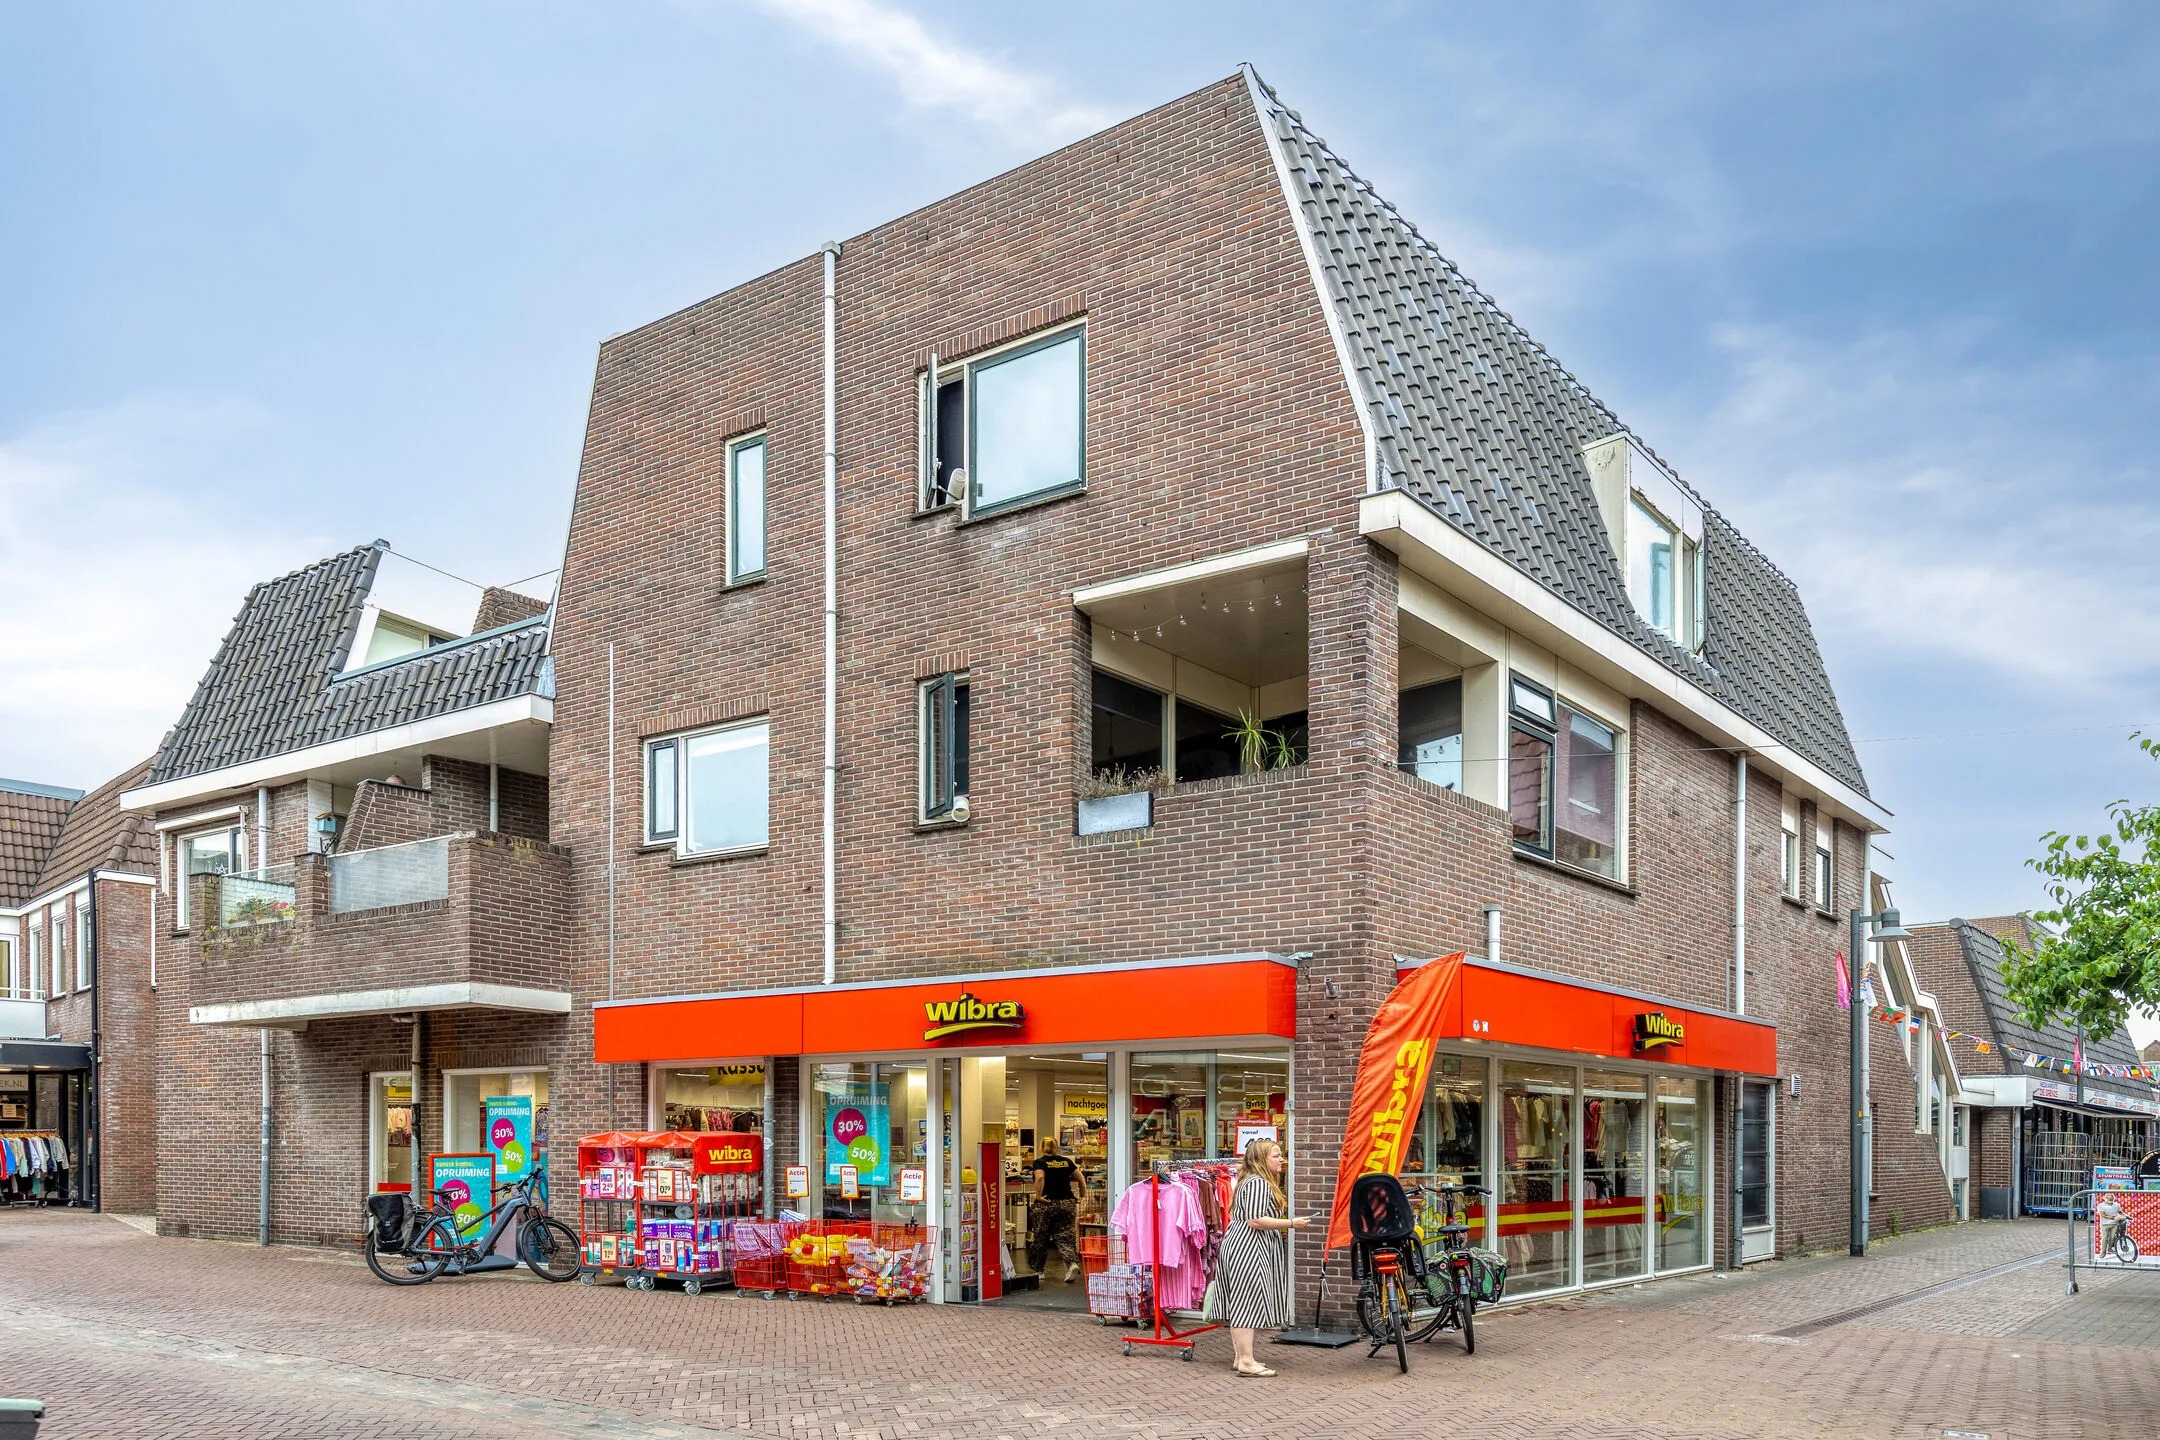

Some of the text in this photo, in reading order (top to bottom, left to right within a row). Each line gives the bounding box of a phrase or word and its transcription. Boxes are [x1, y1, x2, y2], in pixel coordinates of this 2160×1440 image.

[829, 1096, 887, 1106] OPRUIMING
[489, 1108, 530, 1116] OPRUIMING
[838, 1120, 864, 1133] 30%
[495, 1128, 513, 1139] 30%
[505, 1150, 522, 1164] 50%
[852, 1147, 876, 1163] 50%
[435, 1168, 490, 1178] OPRUIMING
[903, 1172, 922, 1180] Actie
[450, 1188, 468, 1201] 0%
